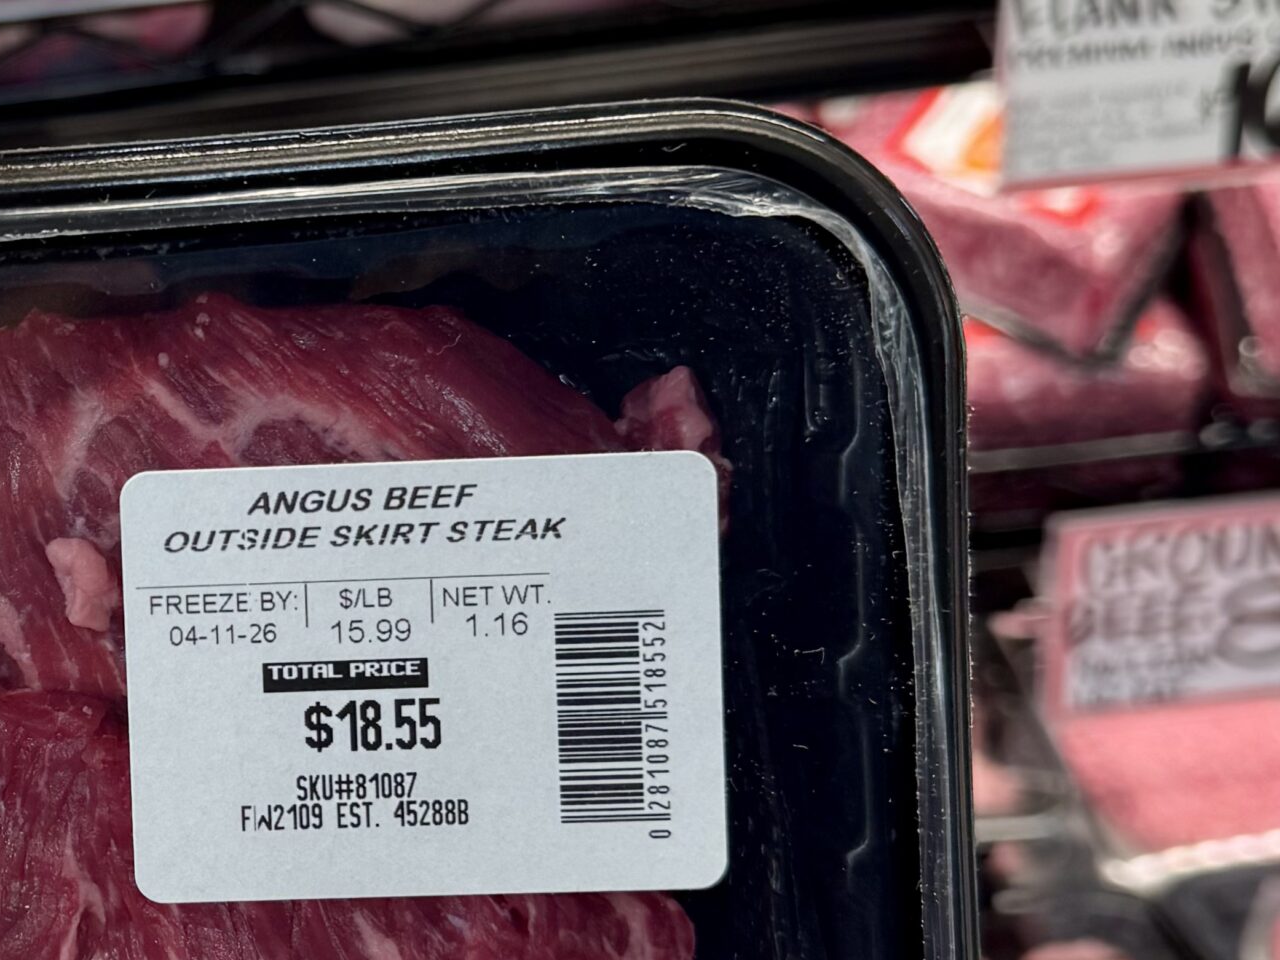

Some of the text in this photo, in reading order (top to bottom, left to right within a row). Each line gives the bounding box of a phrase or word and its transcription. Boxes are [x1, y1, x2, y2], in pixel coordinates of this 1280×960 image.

[248, 484, 478, 516] ANGUS BEEF
[162, 516, 568, 553] OUTSIDE SKIRT STEAK
[149, 590, 300, 615] FREEZE BY:
[339, 587, 393, 610] $/LB
[442, 583, 551, 608] NET WT.
[169, 623, 277, 647] 04-11-26
[330, 618, 412, 645] 15.99
[465, 611, 529, 638] 1.16
[267, 659, 422, 680] TOTAL PRICE
[304, 697, 442, 752] $18.55
[296, 772, 417, 801] SKU#81087
[337, 801, 380, 829] EST.
[394, 799, 470, 827] 45288B
